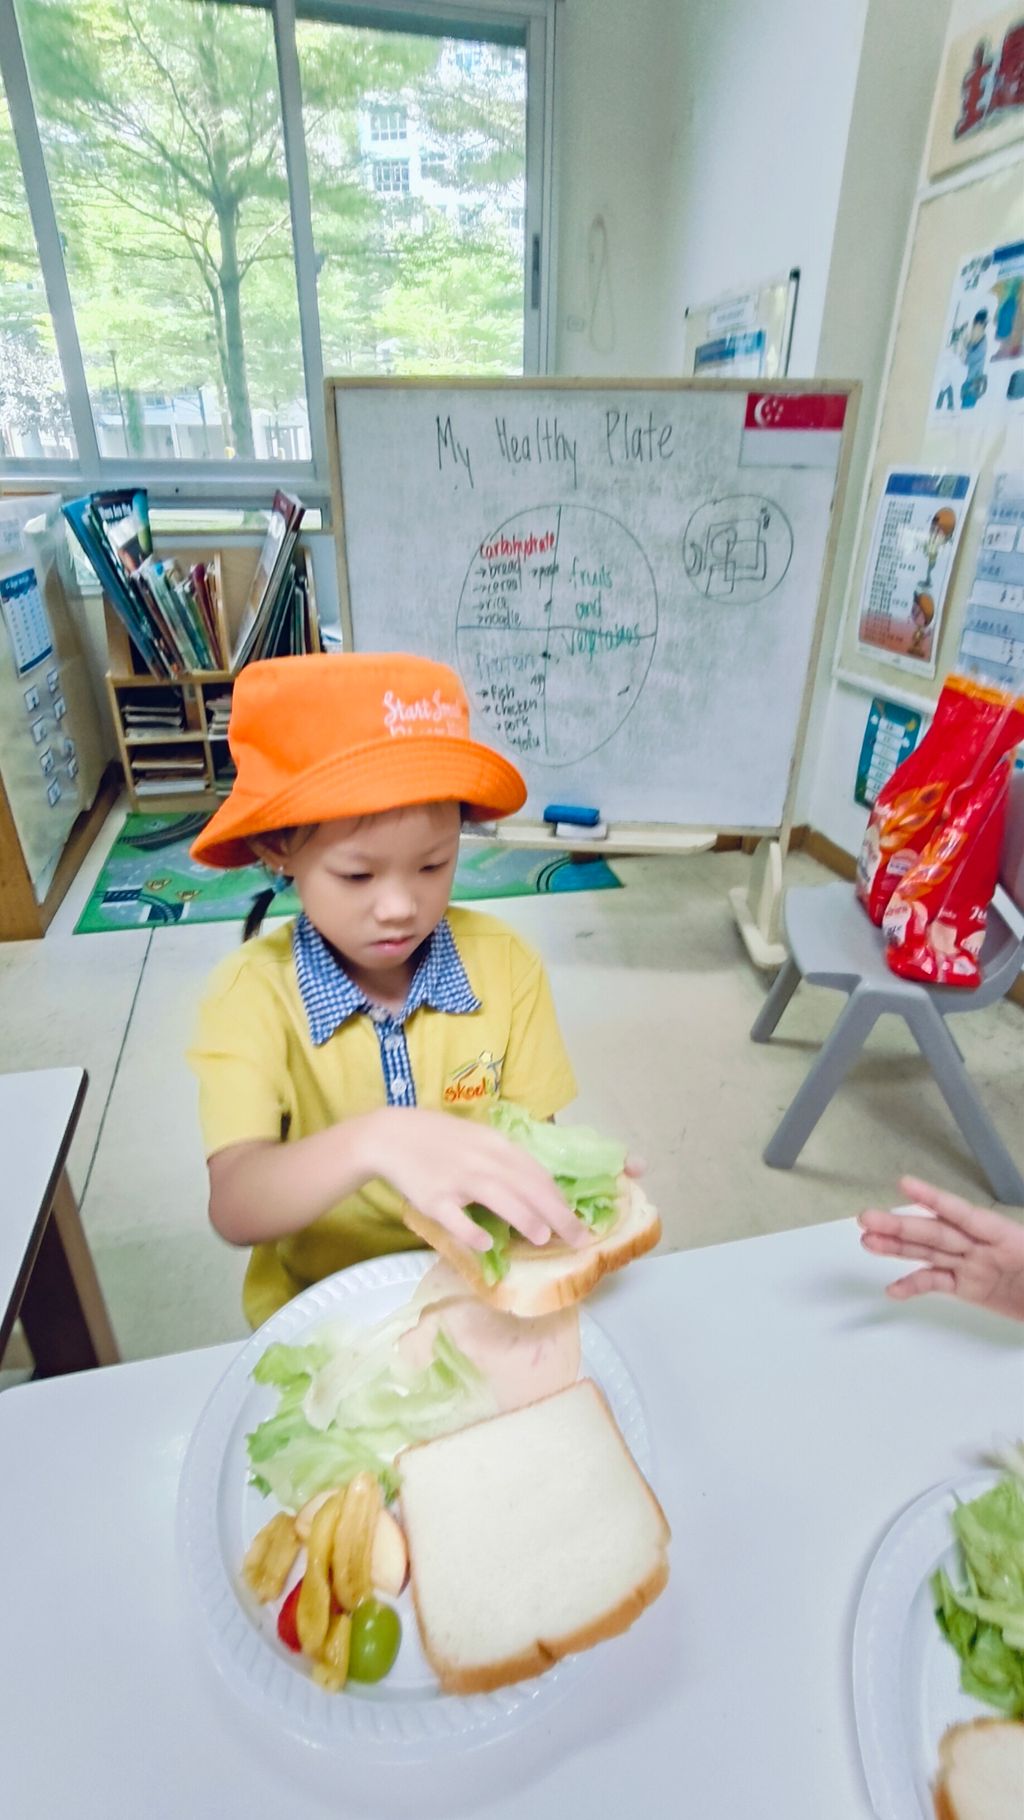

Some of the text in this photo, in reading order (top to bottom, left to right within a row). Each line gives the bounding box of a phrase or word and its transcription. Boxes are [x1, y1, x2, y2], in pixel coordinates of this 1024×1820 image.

[436, 411, 673, 490] My Healthy Plate
